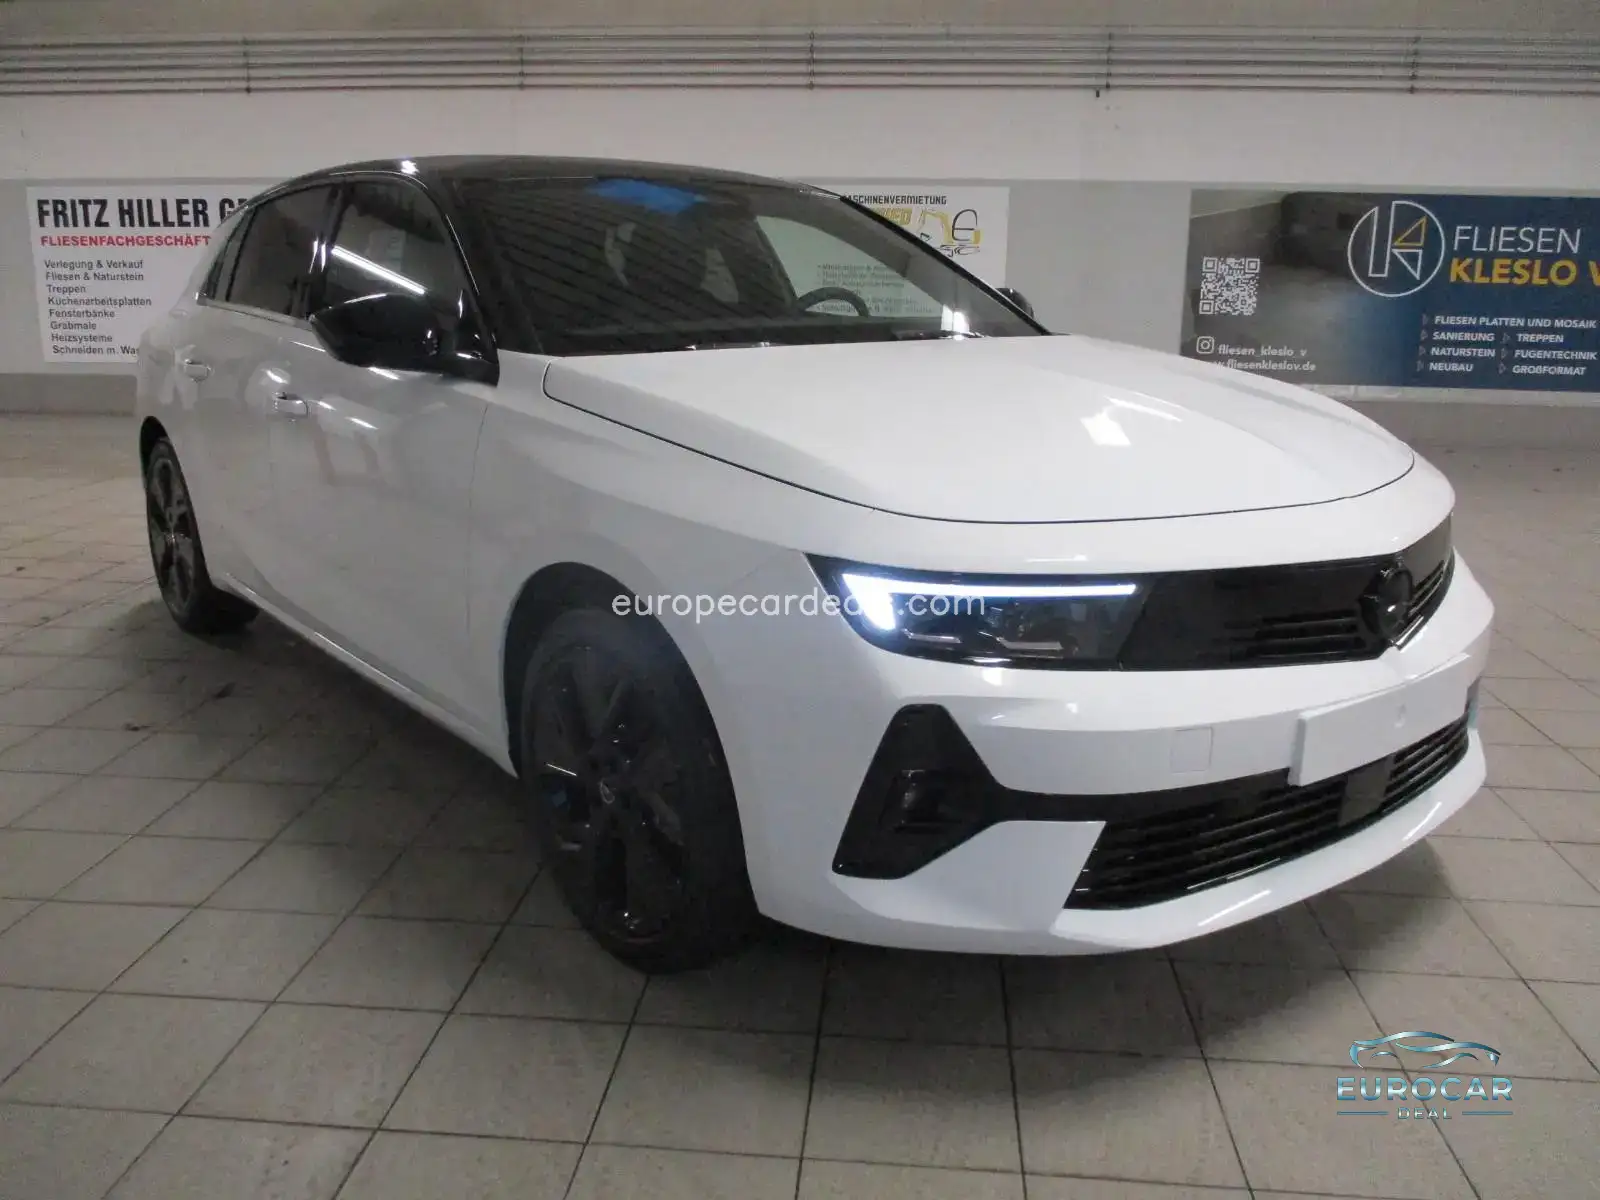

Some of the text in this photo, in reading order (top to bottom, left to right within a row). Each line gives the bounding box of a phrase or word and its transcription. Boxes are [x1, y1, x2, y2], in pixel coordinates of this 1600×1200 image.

[37, 199, 110, 228] FRITZ
[119, 199, 209, 227] HILLER
[40, 235, 211, 247] FLIESENFACHGESCHÄFT
[1454, 225, 1581, 254] FLIESEN
[44, 259, 144, 270] Verlegung & Verkauf
[46, 271, 144, 281] Fliesen & Naturstein
[1450, 257, 1578, 286] KLESLO
[46, 284, 86, 295] Treppen
[50, 321, 97, 330] Grabmale
[1434, 315, 1597, 329] FLIESEN PLATTEN UND MOSAIK
[51, 333, 113, 344] Heizsysteme
[1432, 332, 1495, 342] SANIERUNG
[1516, 333, 1564, 343] TREPPEN
[52, 345, 104, 355] Schneiden
[106, 347, 119, 355] m.
[1431, 347, 1496, 357] NATURSTEIN
[1514, 350, 1598, 360] FUGENTECHNIK
[1429, 362, 1474, 372] NEUBAU
